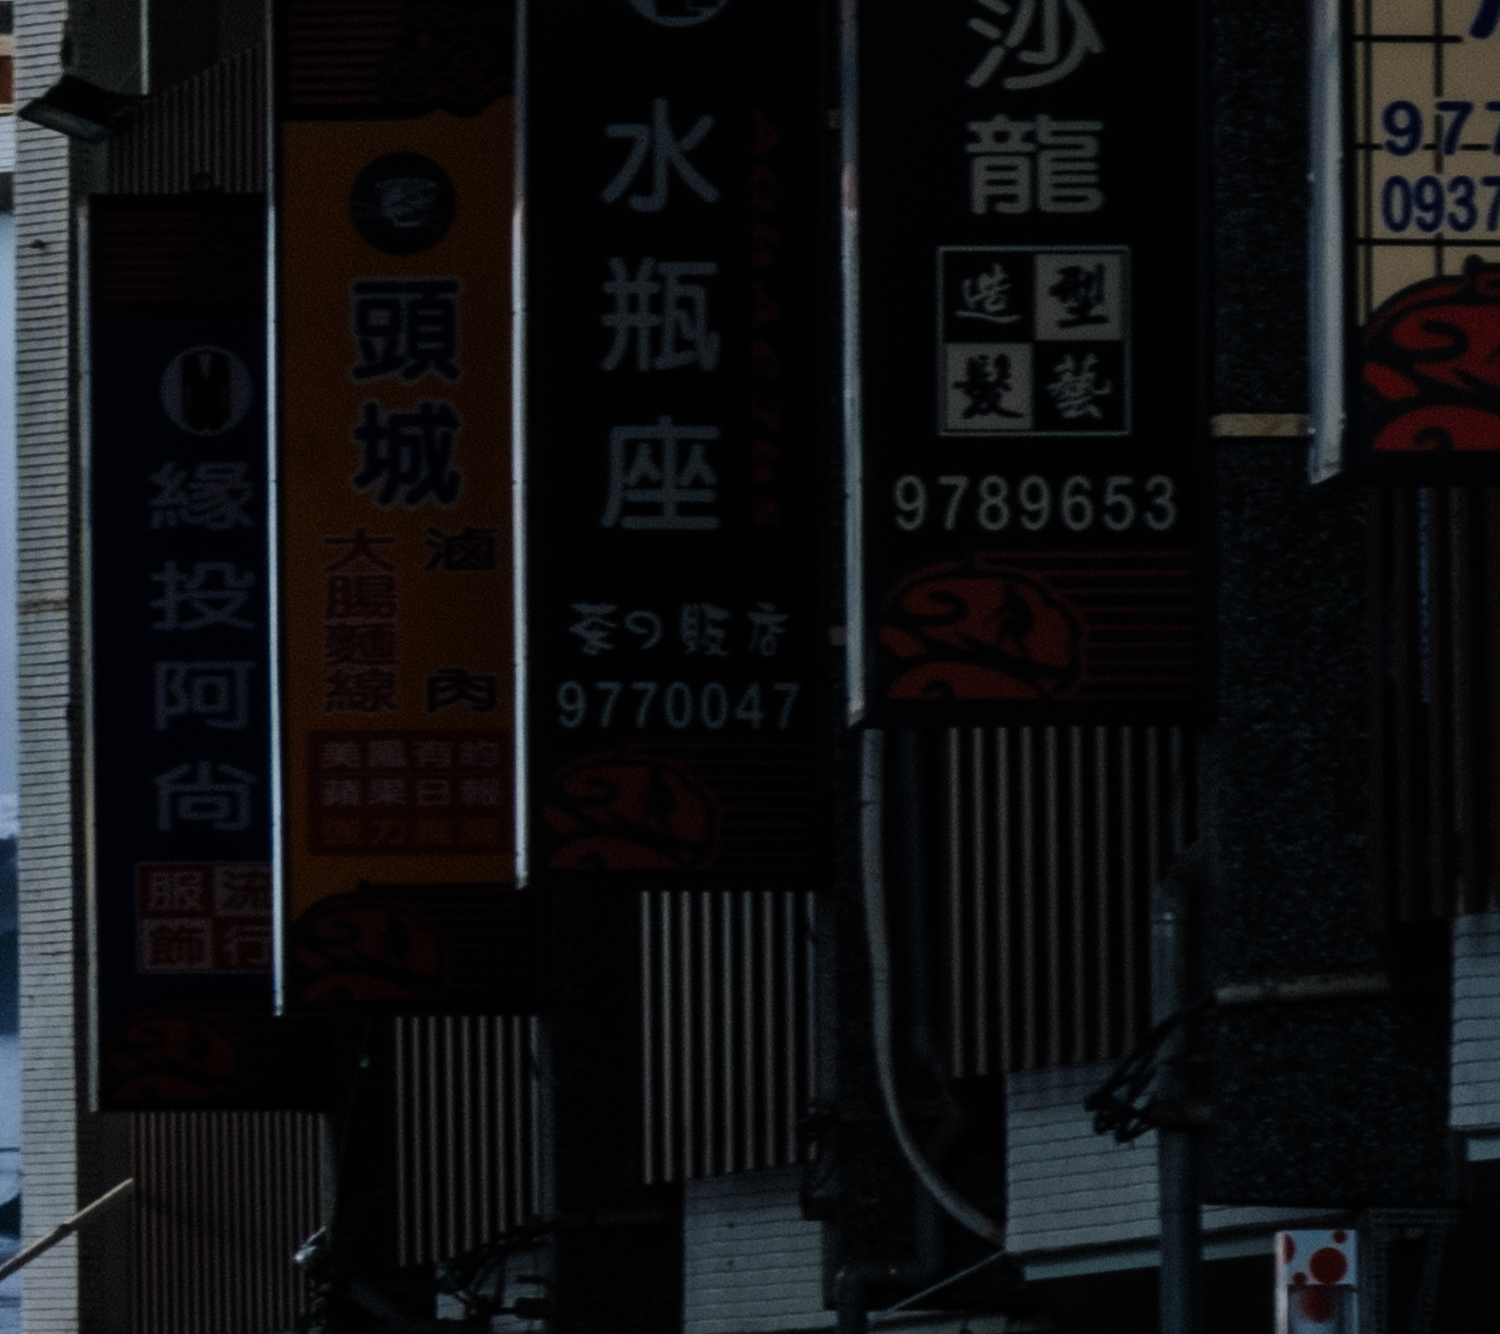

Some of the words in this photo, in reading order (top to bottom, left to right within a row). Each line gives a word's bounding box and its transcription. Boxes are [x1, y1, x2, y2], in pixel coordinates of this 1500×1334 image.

[350, 277, 463, 508] 頭城
[597, 97, 723, 533] 水瓶座
[890, 472, 1182, 533] 9789653
[147, 458, 260, 833] 緣投阿尚
[554, 679, 803, 730] 9770047
